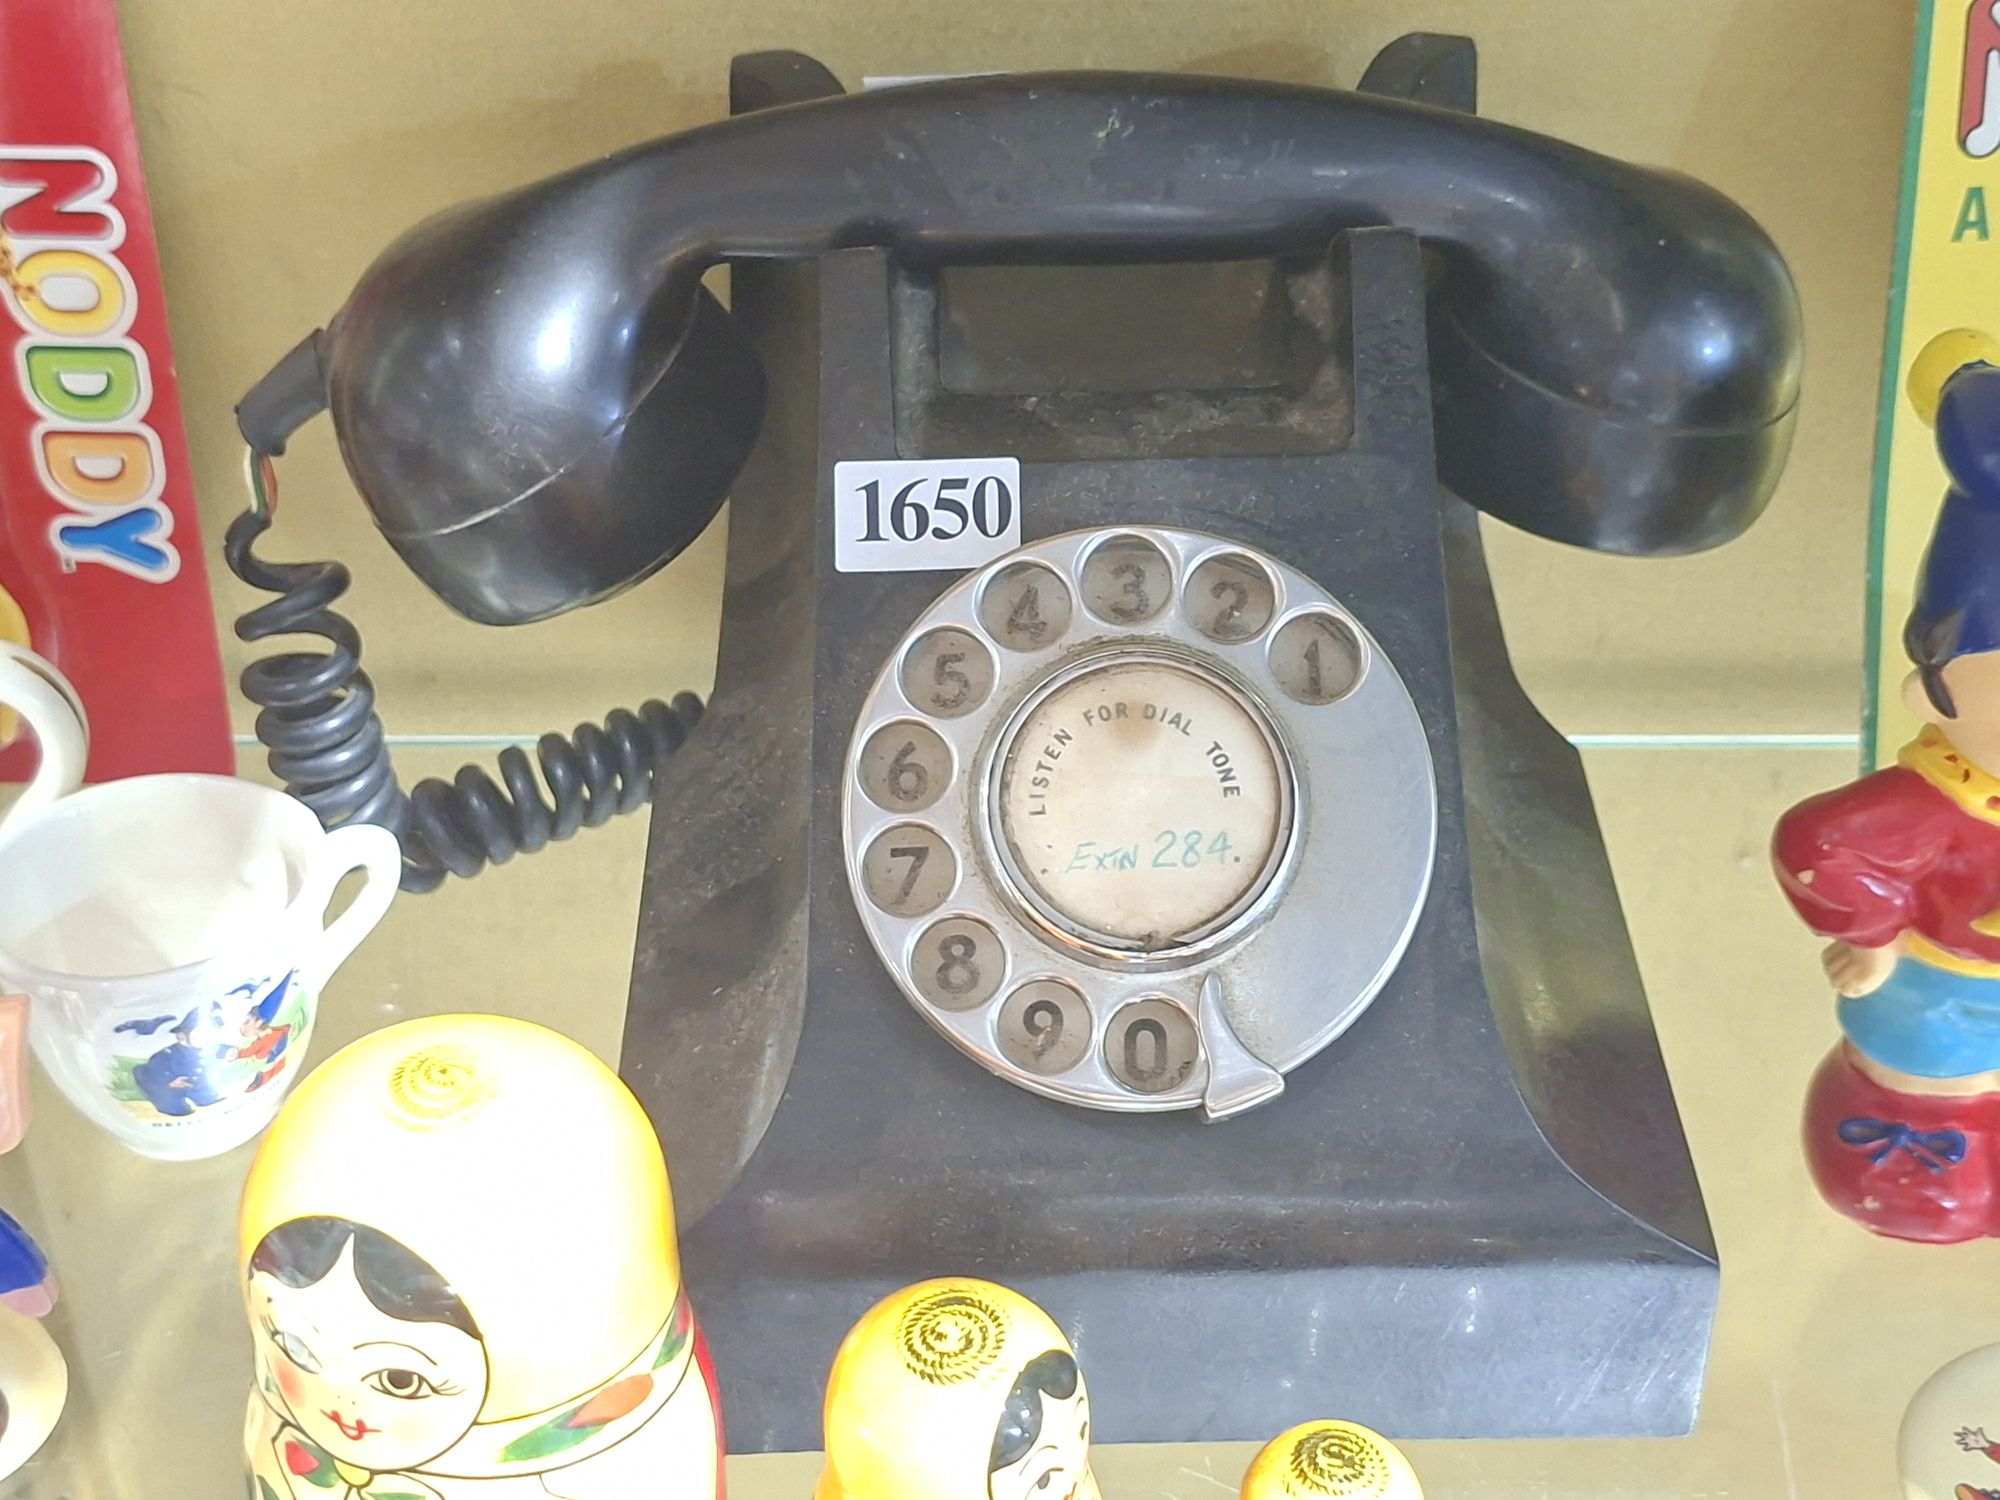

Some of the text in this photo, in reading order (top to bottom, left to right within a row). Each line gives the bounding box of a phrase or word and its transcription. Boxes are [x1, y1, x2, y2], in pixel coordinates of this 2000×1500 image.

[0, 146, 180, 584] NODDY
[855, 475, 1012, 543] 1650
[1009, 582, 1049, 638] 4
[1112, 562, 1147, 619] 3
[1211, 580, 1249, 639] 2
[931, 652, 973, 707] 5
[1304, 639, 1323, 696] 1
[889, 740, 929, 802] 6
[1029, 702, 1241, 816] LISTEN FOR DIAL TONE
[889, 846, 930, 906] 7
[935, 933, 978, 994] 8
[1022, 998, 1064, 1061] 9
[1124, 1018, 1168, 1081] 0
